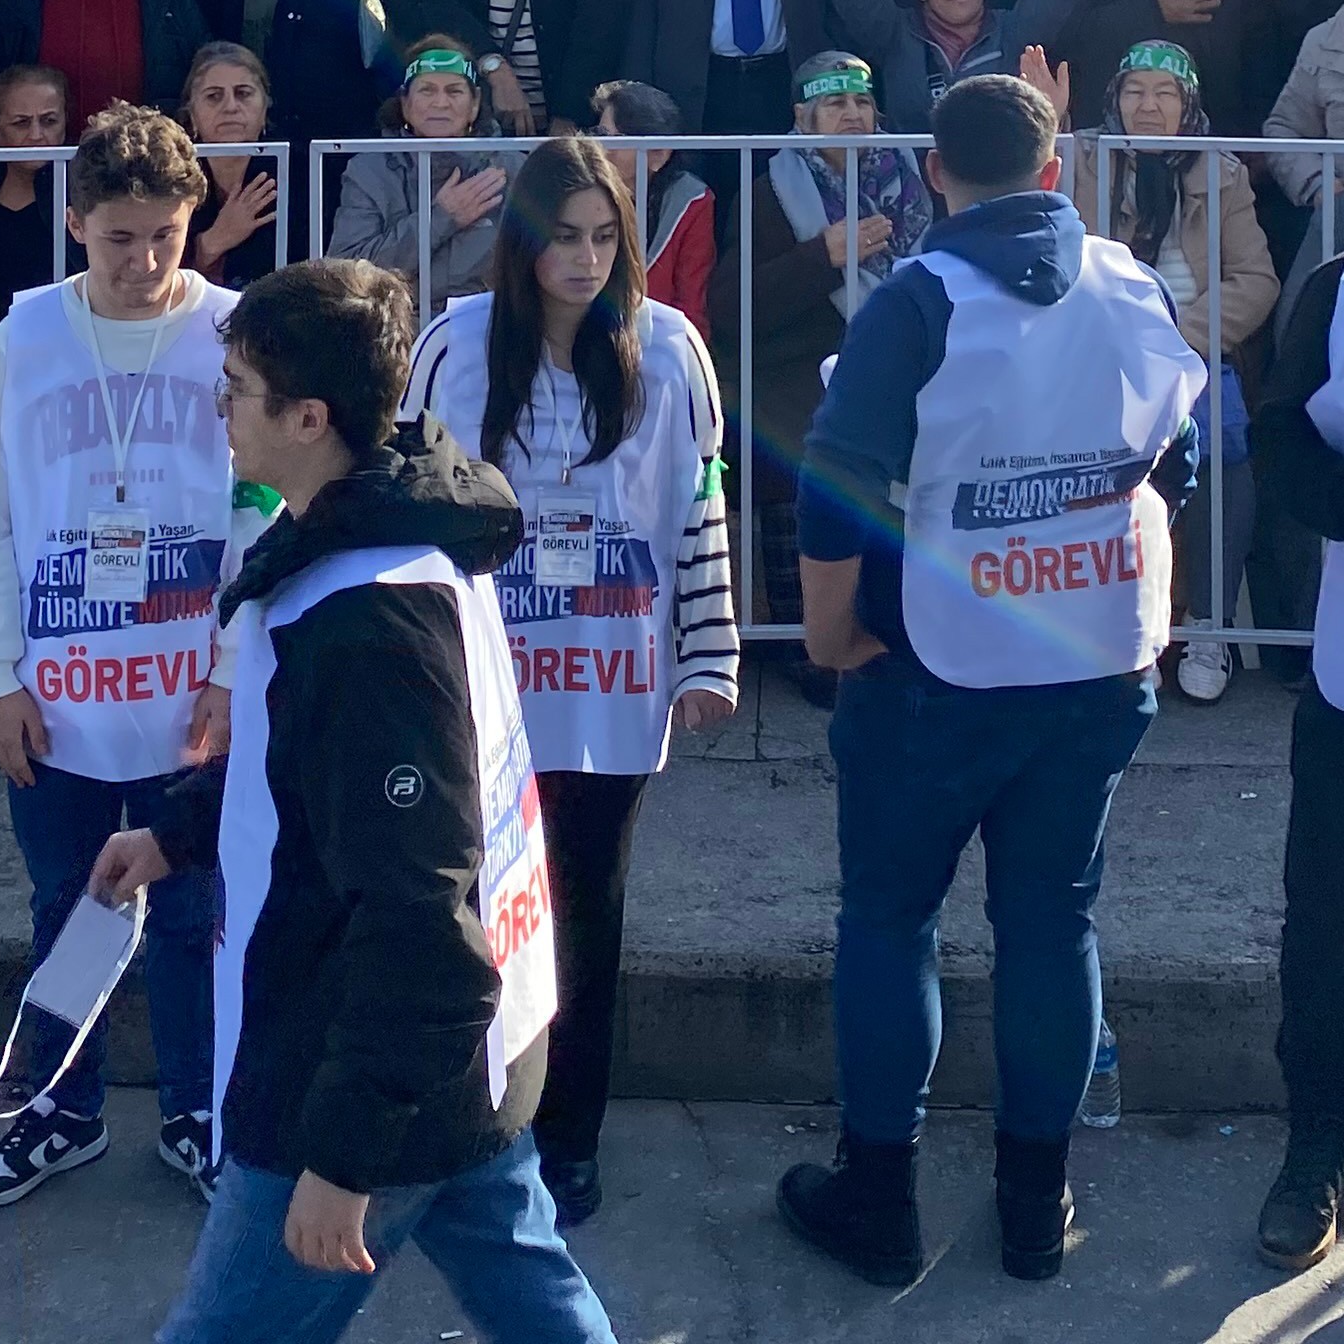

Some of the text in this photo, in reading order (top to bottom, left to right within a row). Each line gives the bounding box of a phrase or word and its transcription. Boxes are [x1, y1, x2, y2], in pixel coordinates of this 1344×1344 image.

[803, 74, 849, 99] MEDET
[972, 469, 1116, 507] DEMOKRATİK
[542, 535, 590, 551] GÖREVLİ
[92, 551, 141, 567] GÖREVLİ
[971, 518, 1145, 599] GÖREVLİ
